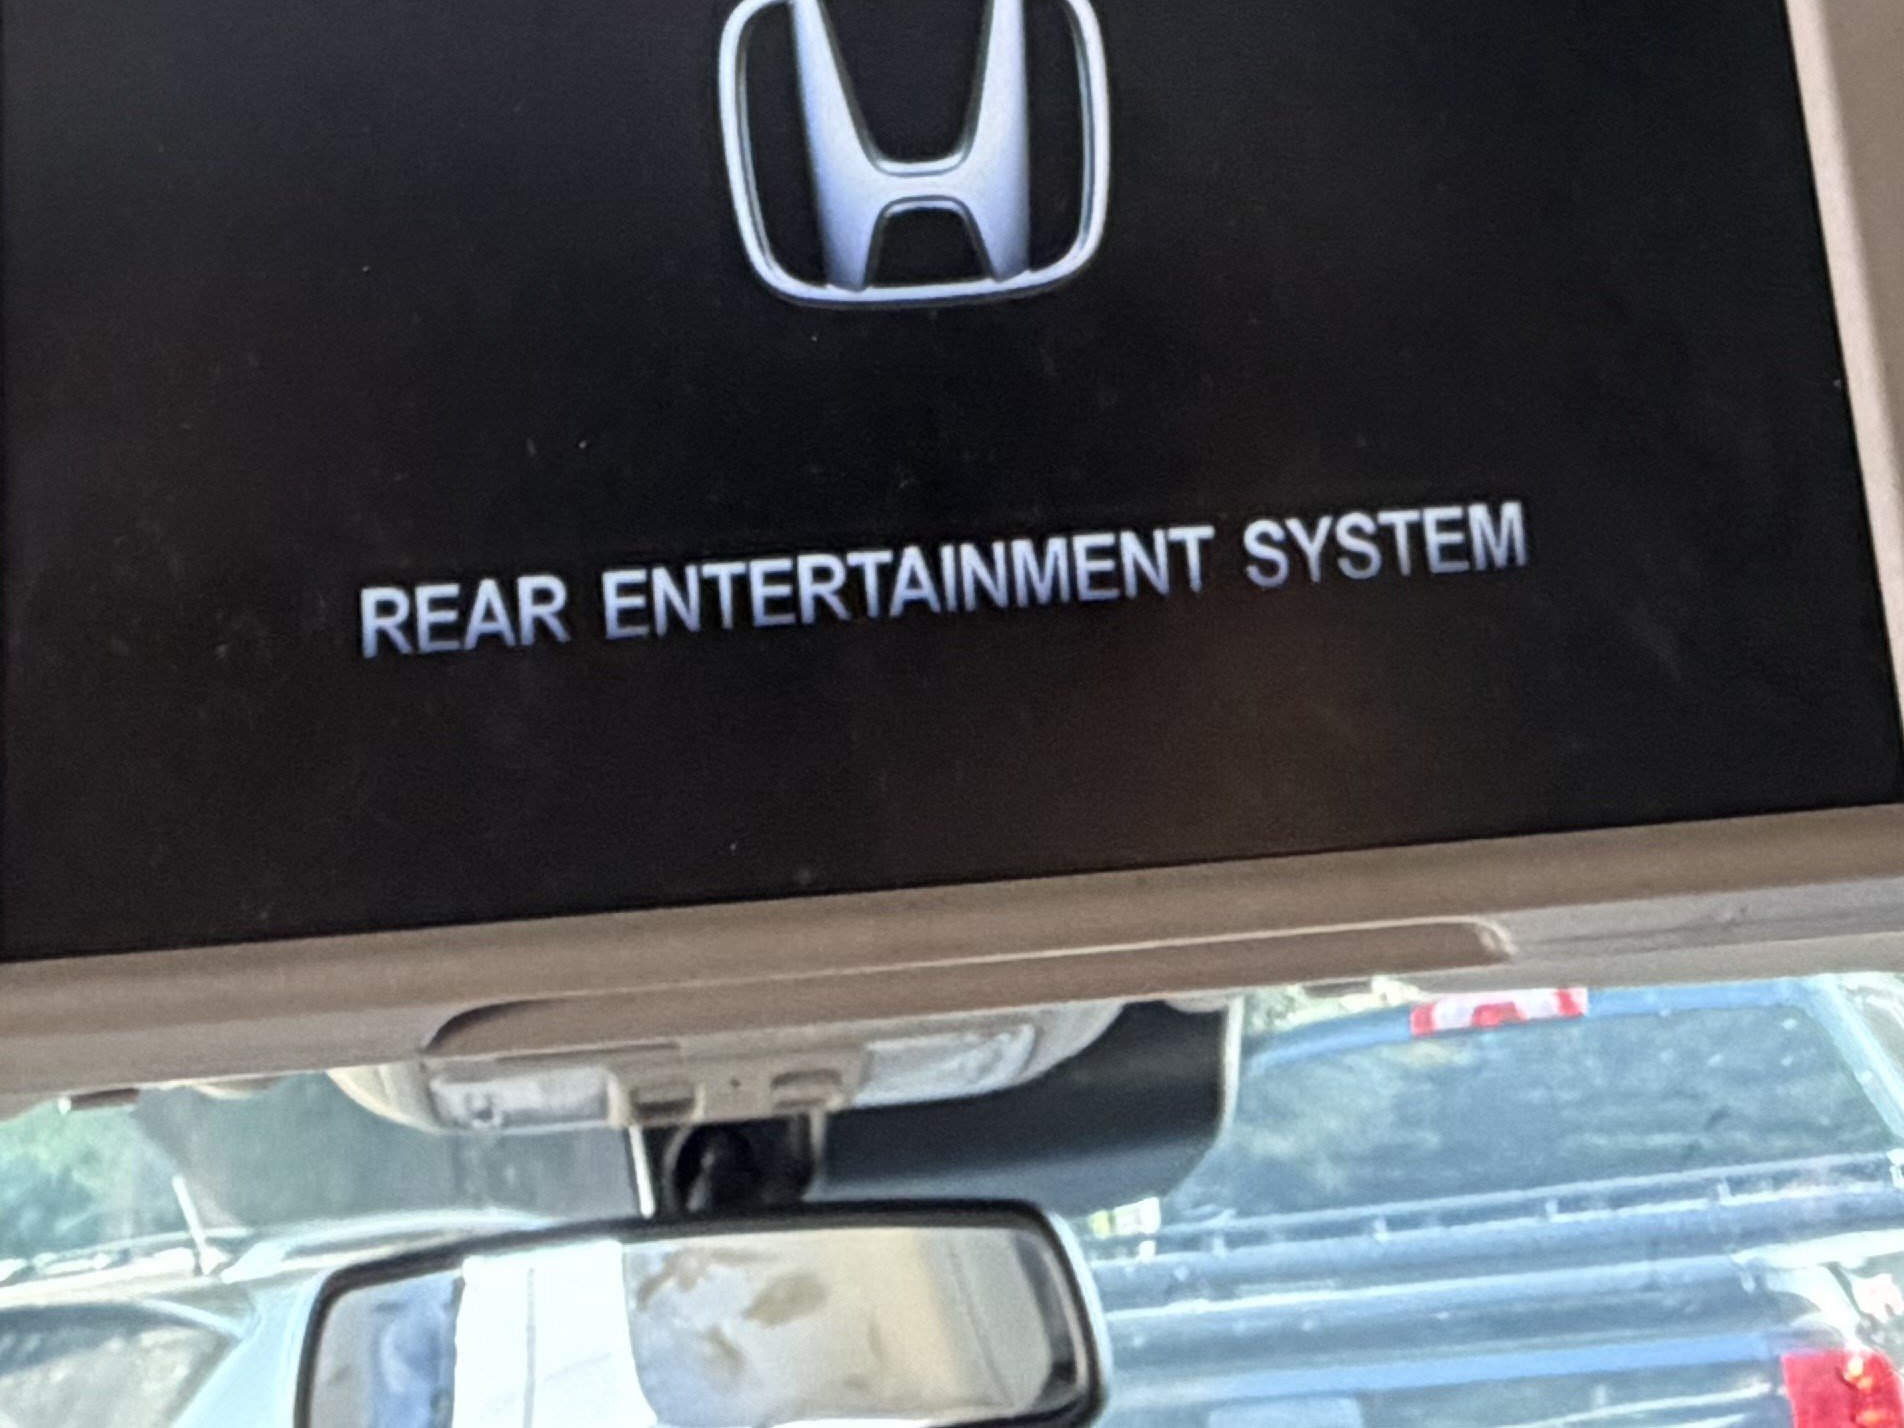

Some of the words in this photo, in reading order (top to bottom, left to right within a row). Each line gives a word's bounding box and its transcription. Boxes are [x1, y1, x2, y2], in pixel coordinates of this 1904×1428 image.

[359, 573, 567, 655] REAR
[601, 524, 1216, 636] ENTERTAINMENT
[1242, 501, 1525, 585] SYSTEM
